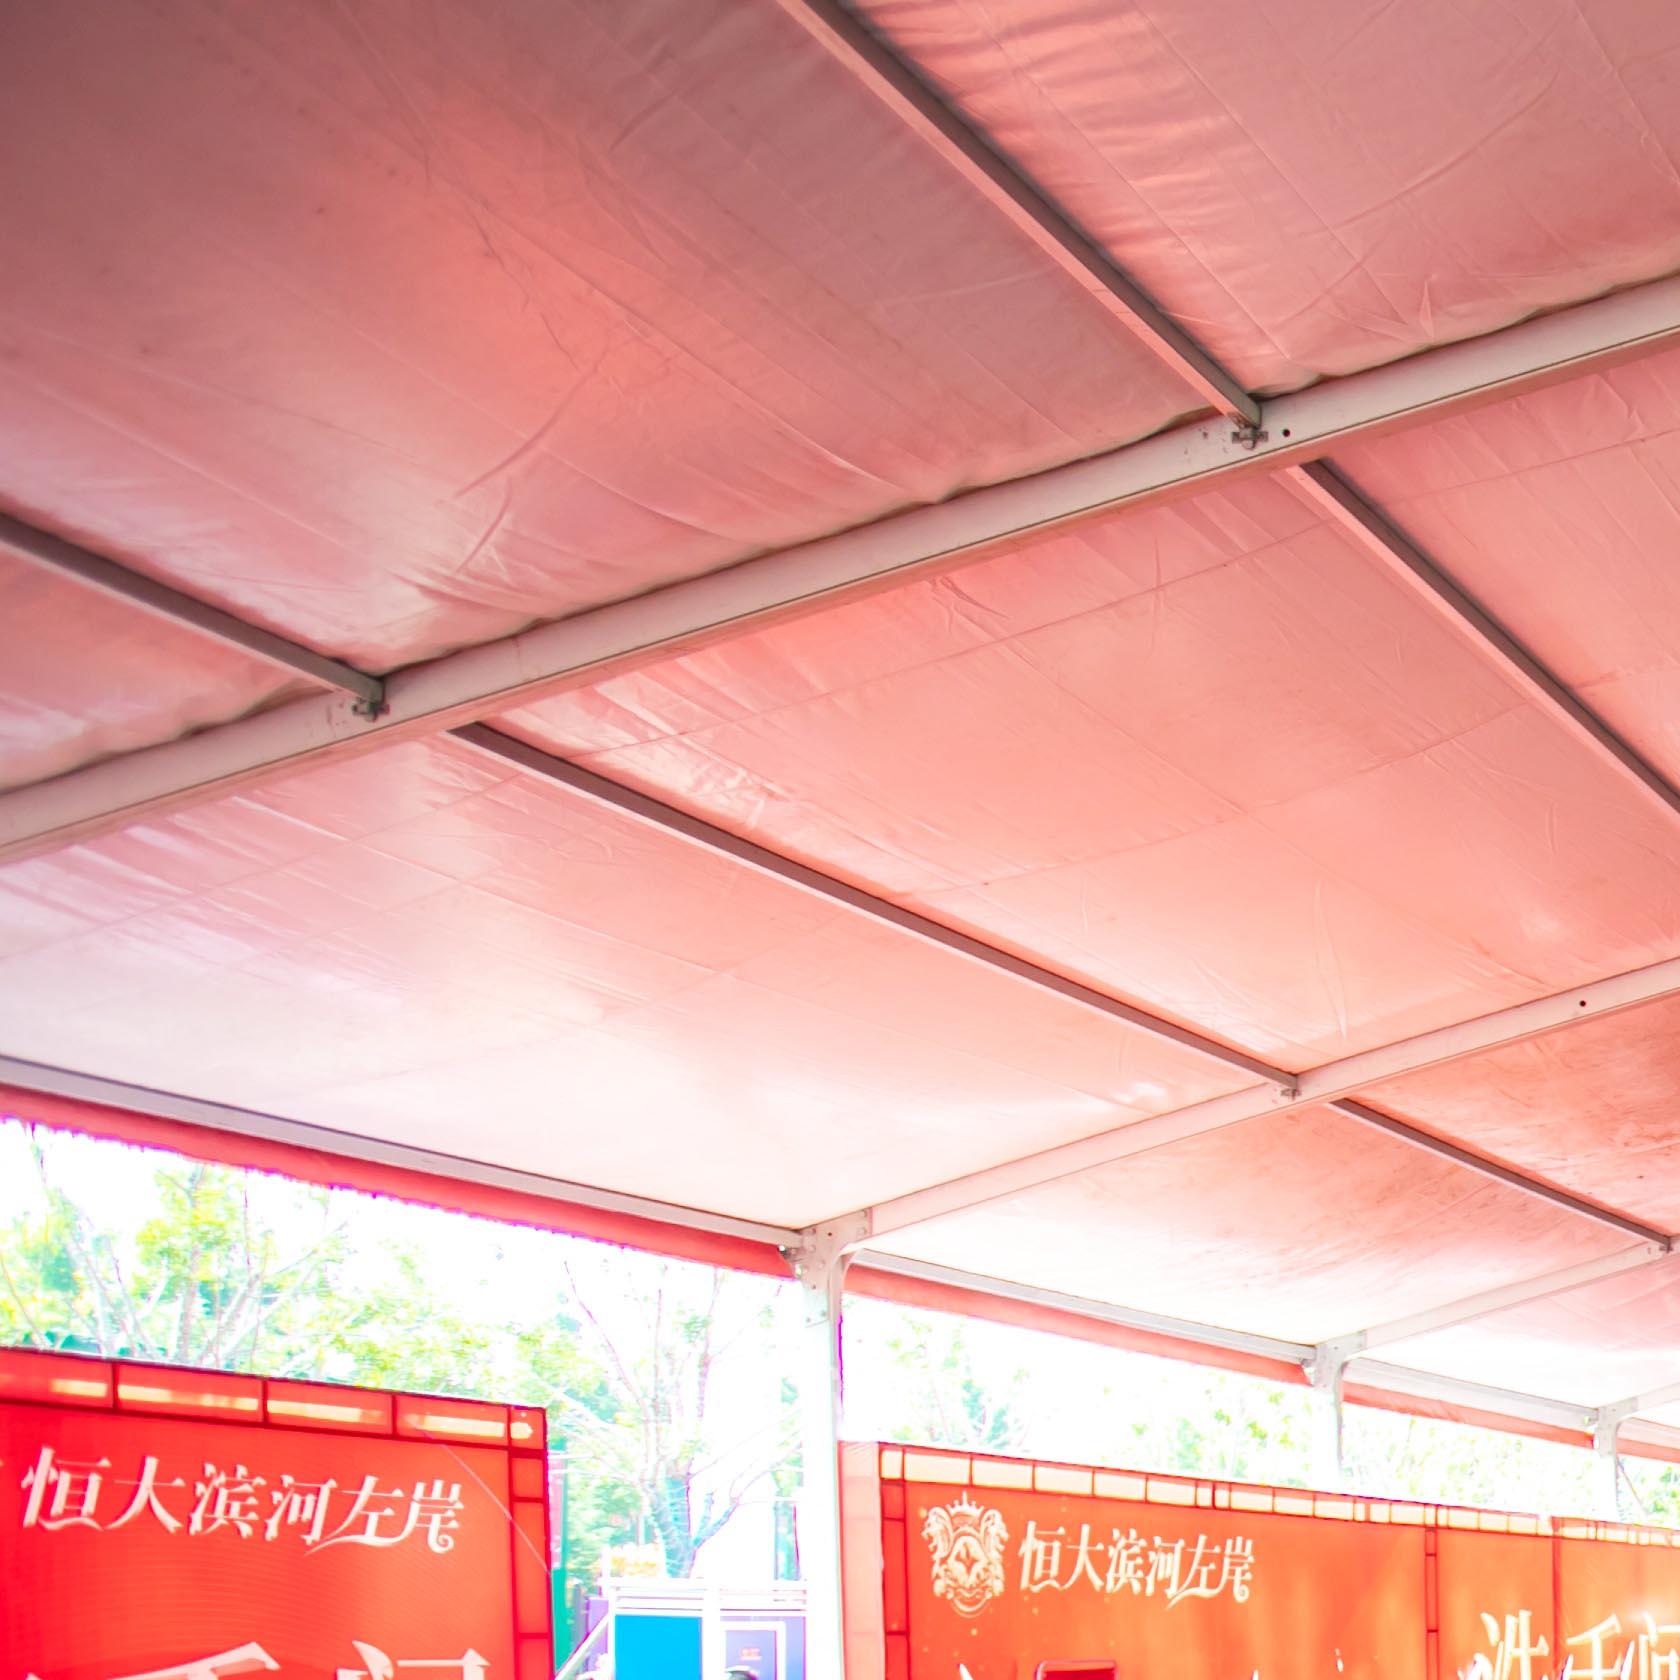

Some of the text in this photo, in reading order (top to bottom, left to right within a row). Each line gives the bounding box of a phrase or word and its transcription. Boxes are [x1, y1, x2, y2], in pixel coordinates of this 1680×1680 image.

[21, 1446, 466, 1554] 恒大滨河左岸
[1018, 1520, 1256, 1611] 恒大滨河左岸
